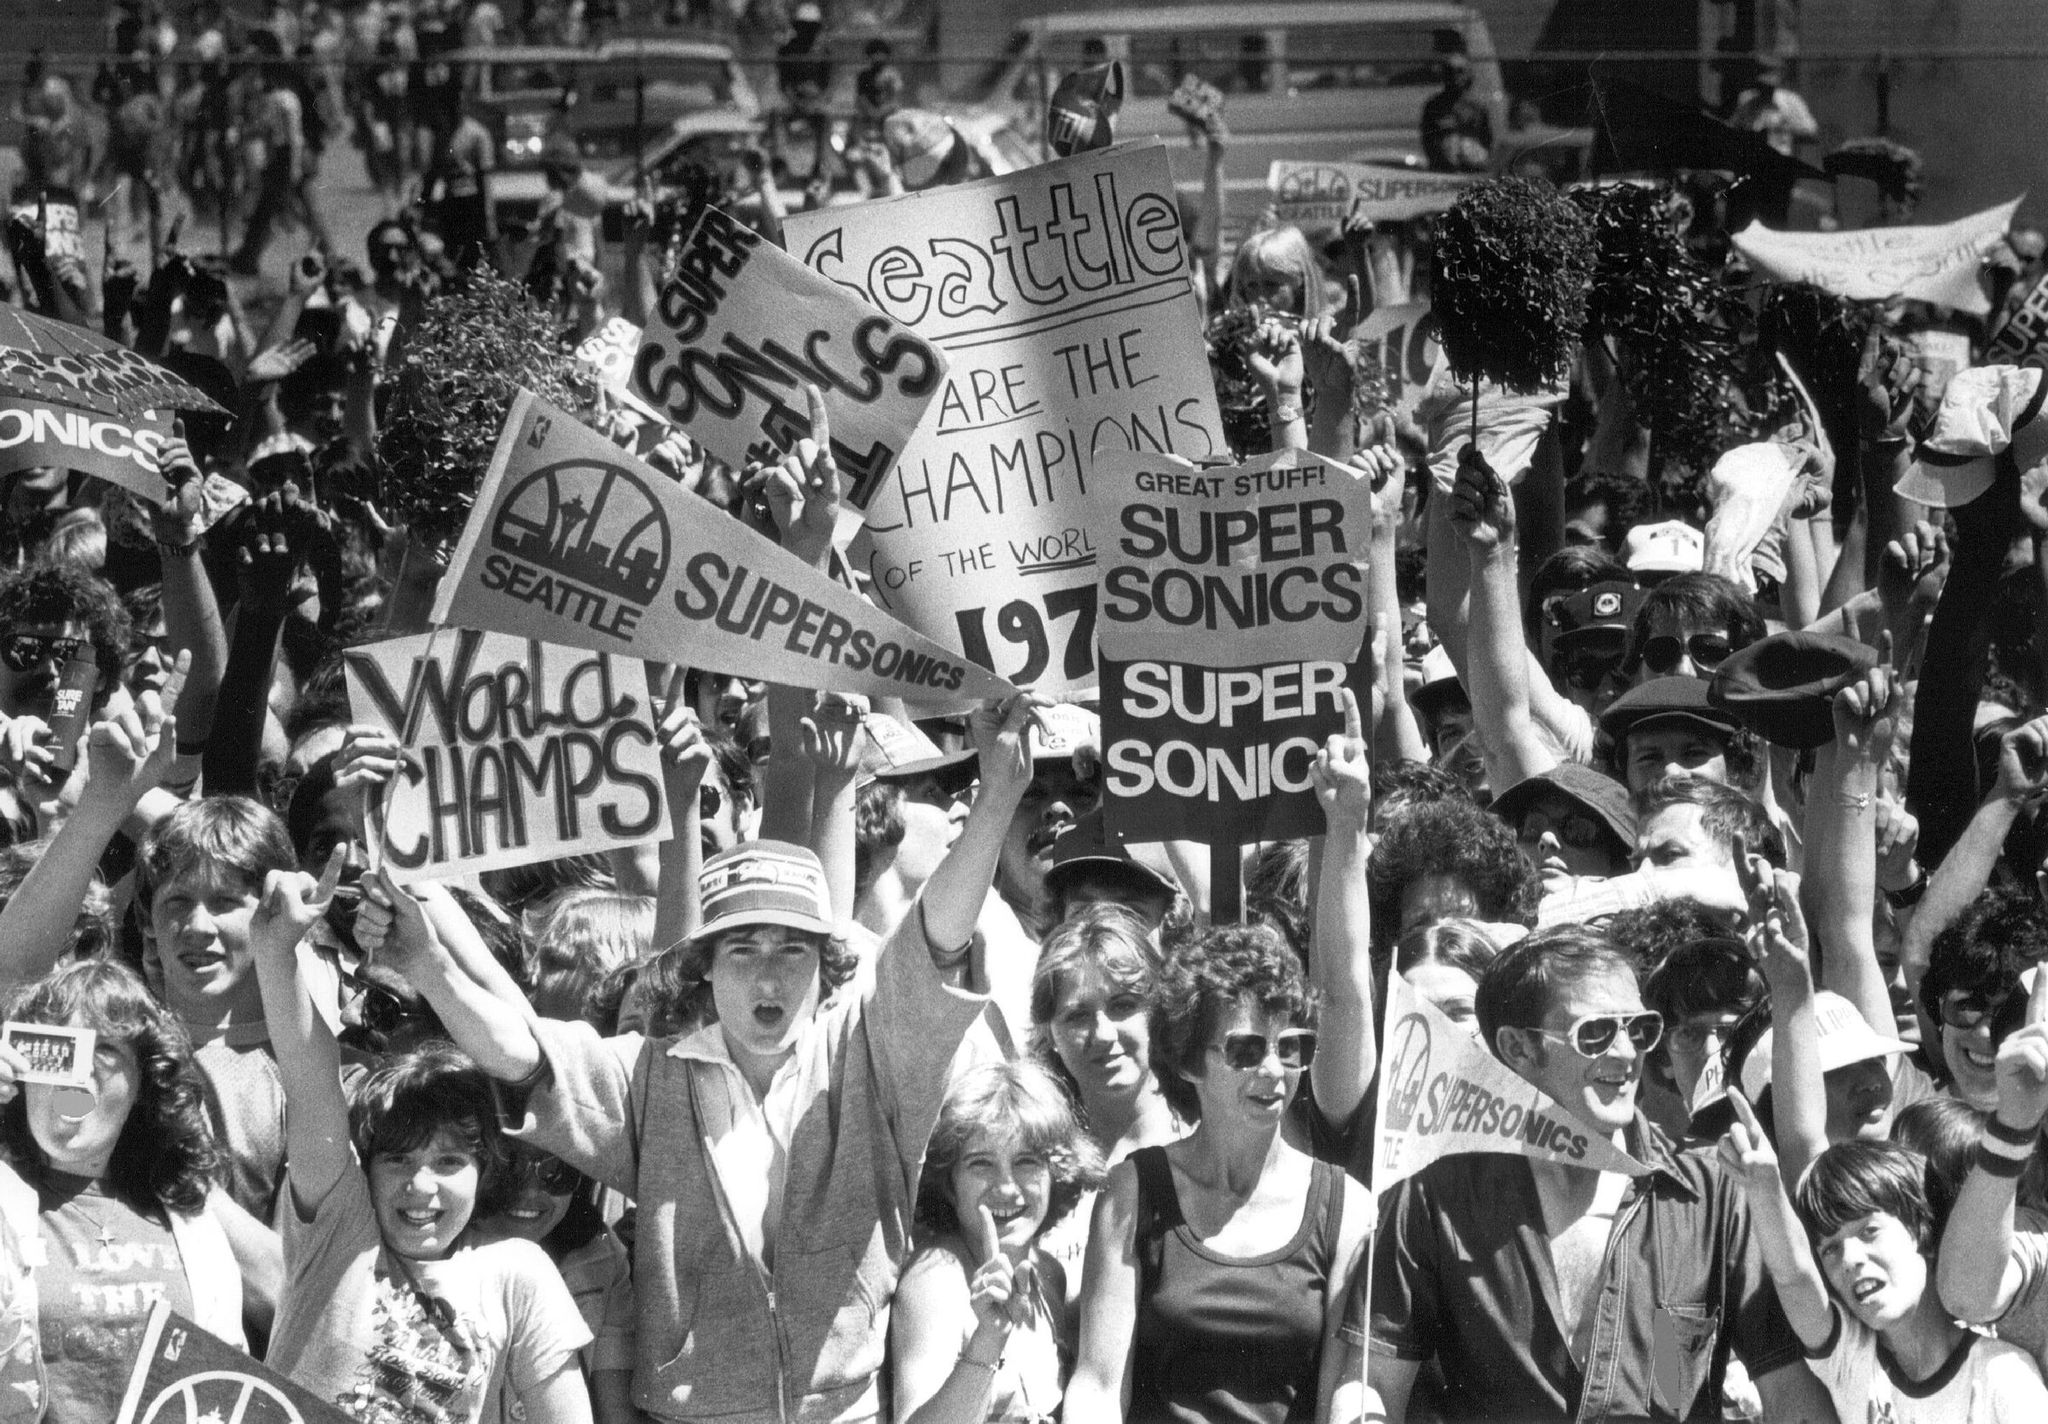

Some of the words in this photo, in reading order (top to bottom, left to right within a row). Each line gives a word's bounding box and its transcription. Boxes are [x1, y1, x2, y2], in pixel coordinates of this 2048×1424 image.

[658, 209, 760, 344] SUPER
[804, 172, 1183, 327] Seattle
[634, 315, 939, 425] SONICS
[939, 364, 1040, 428] ARE
[1053, 329, 1159, 398] THE
[864, 398, 1213, 533] HAMPIONS
[1135, 471, 1224, 498] GREAT
[1234, 465, 1326, 496] STUFF!
[938, 543, 997, 577] THE
[1008, 528, 1097, 565] WORL
[1120, 499, 1348, 567] SUPER
[480, 554, 643, 643] SEATTLE
[674, 551, 966, 691] SUPERSONICS
[955, 583, 1098, 686] 197
[1104, 562, 1363, 630] SONICS
[57, 700, 77, 711] TAN
[1122, 660, 1348, 728] SUPER
[364, 718, 664, 869] CHAMPS
[1106, 736, 1322, 803] SONIC
